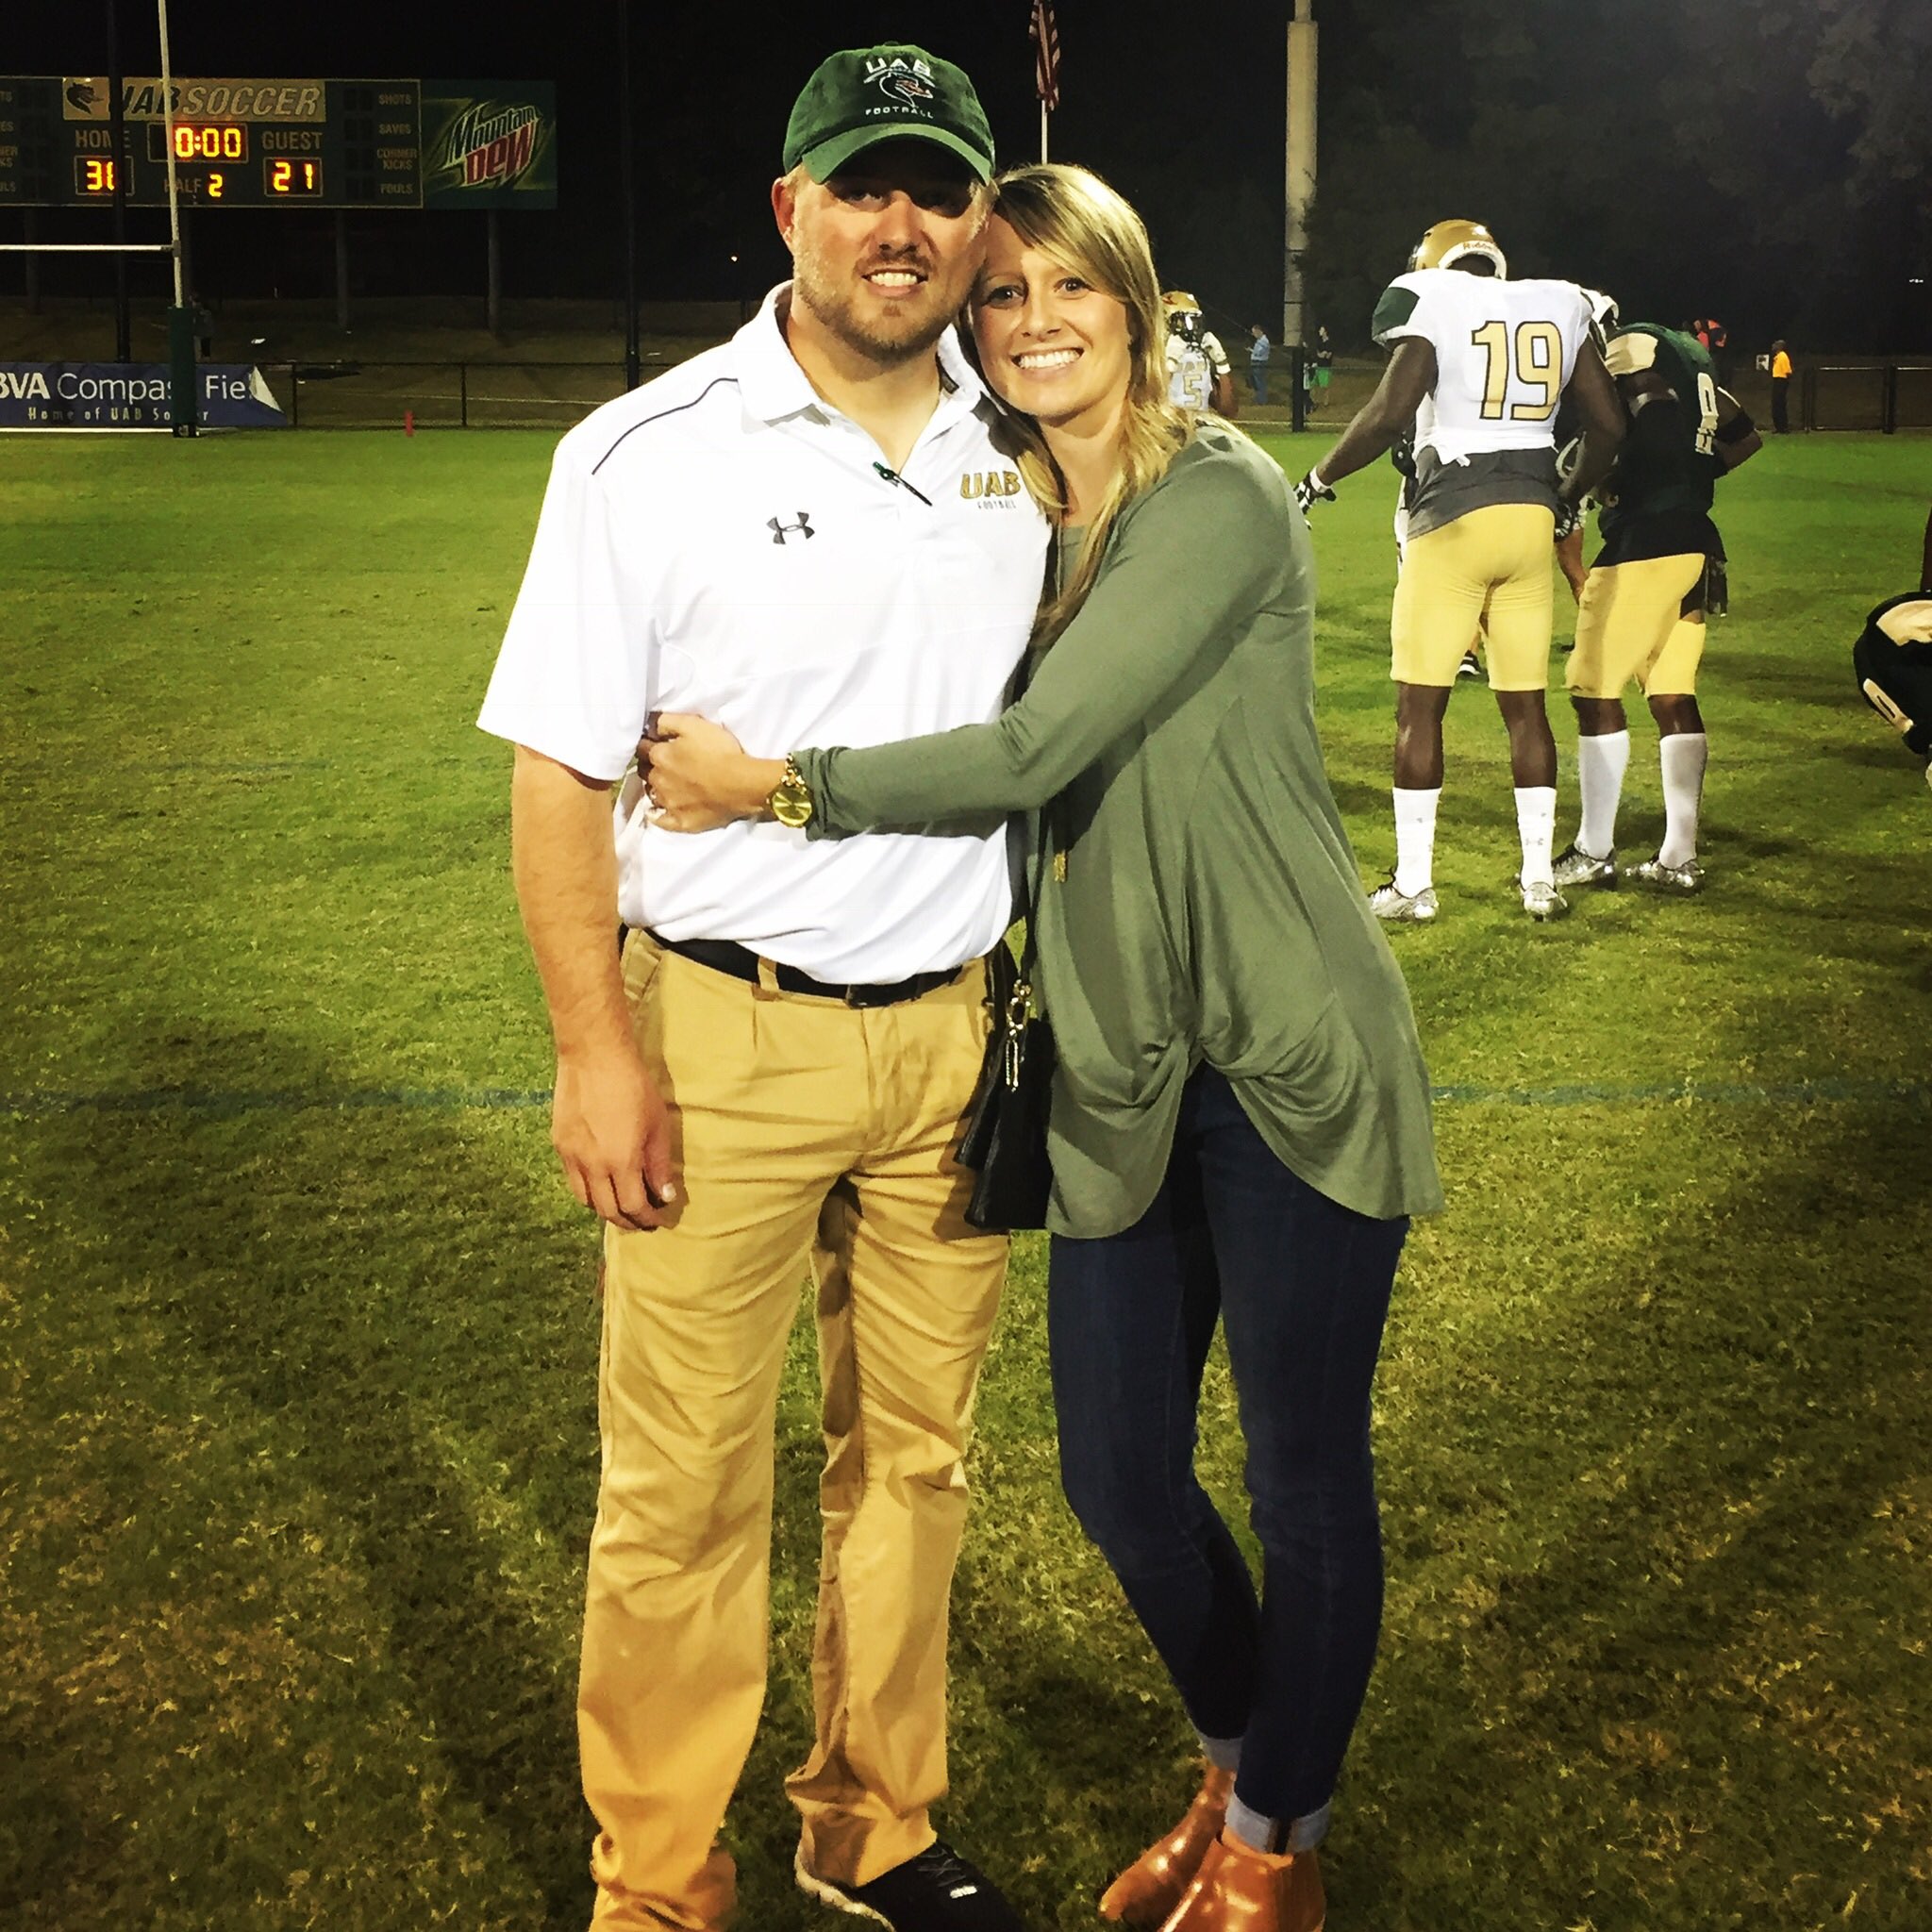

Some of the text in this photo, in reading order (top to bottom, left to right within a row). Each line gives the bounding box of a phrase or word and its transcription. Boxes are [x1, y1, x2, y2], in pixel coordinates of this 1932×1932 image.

[865, 58, 931, 76] UAB
[183, 86, 321, 115] SOCCER
[175, 127, 242, 158] 0:00
[261, 130, 323, 150] GUEST
[208, 174, 223, 197] 2
[273, 161, 314, 192] 21
[1472, 320, 1563, 421] 19
[57, 373, 172, 405] Compa
[205, 375, 246, 400] Fie
[1182, 374, 1203, 408] 5
[28, 407, 75, 421] Home
[85, 407, 101, 421] of
[110, 407, 142, 421] UAB
[960, 471, 1021, 499] UAB
